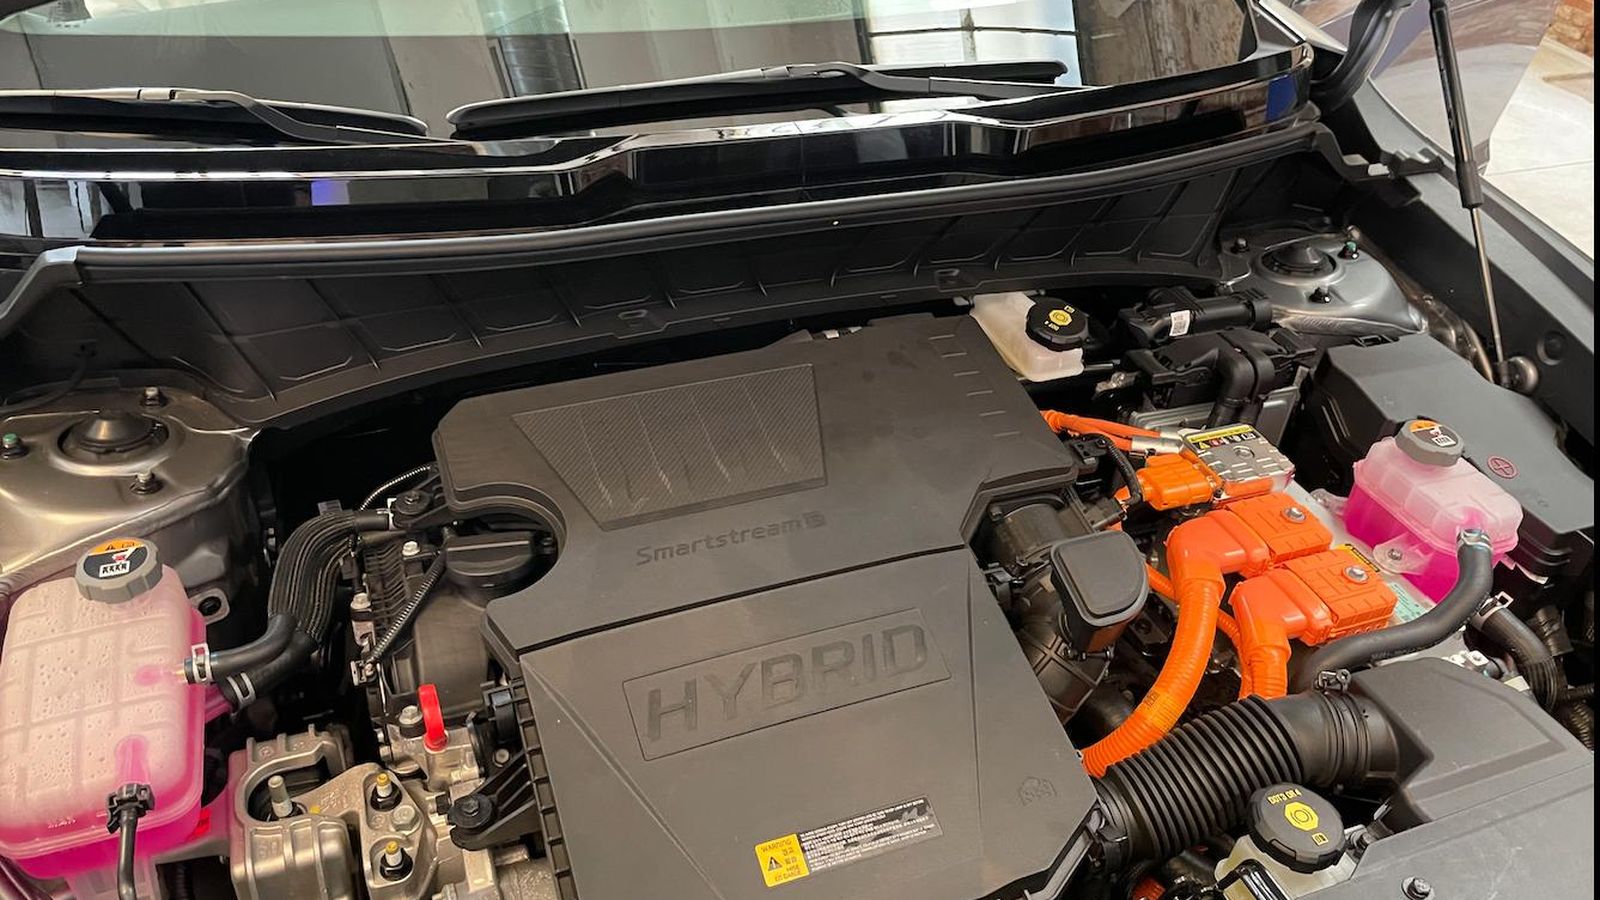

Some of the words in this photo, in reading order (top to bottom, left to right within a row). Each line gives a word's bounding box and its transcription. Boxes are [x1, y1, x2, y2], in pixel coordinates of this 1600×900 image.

[636, 517, 800, 566] Smartstream
[647, 623, 928, 743] HYBRID
[760, 839, 793, 853] WARNING
